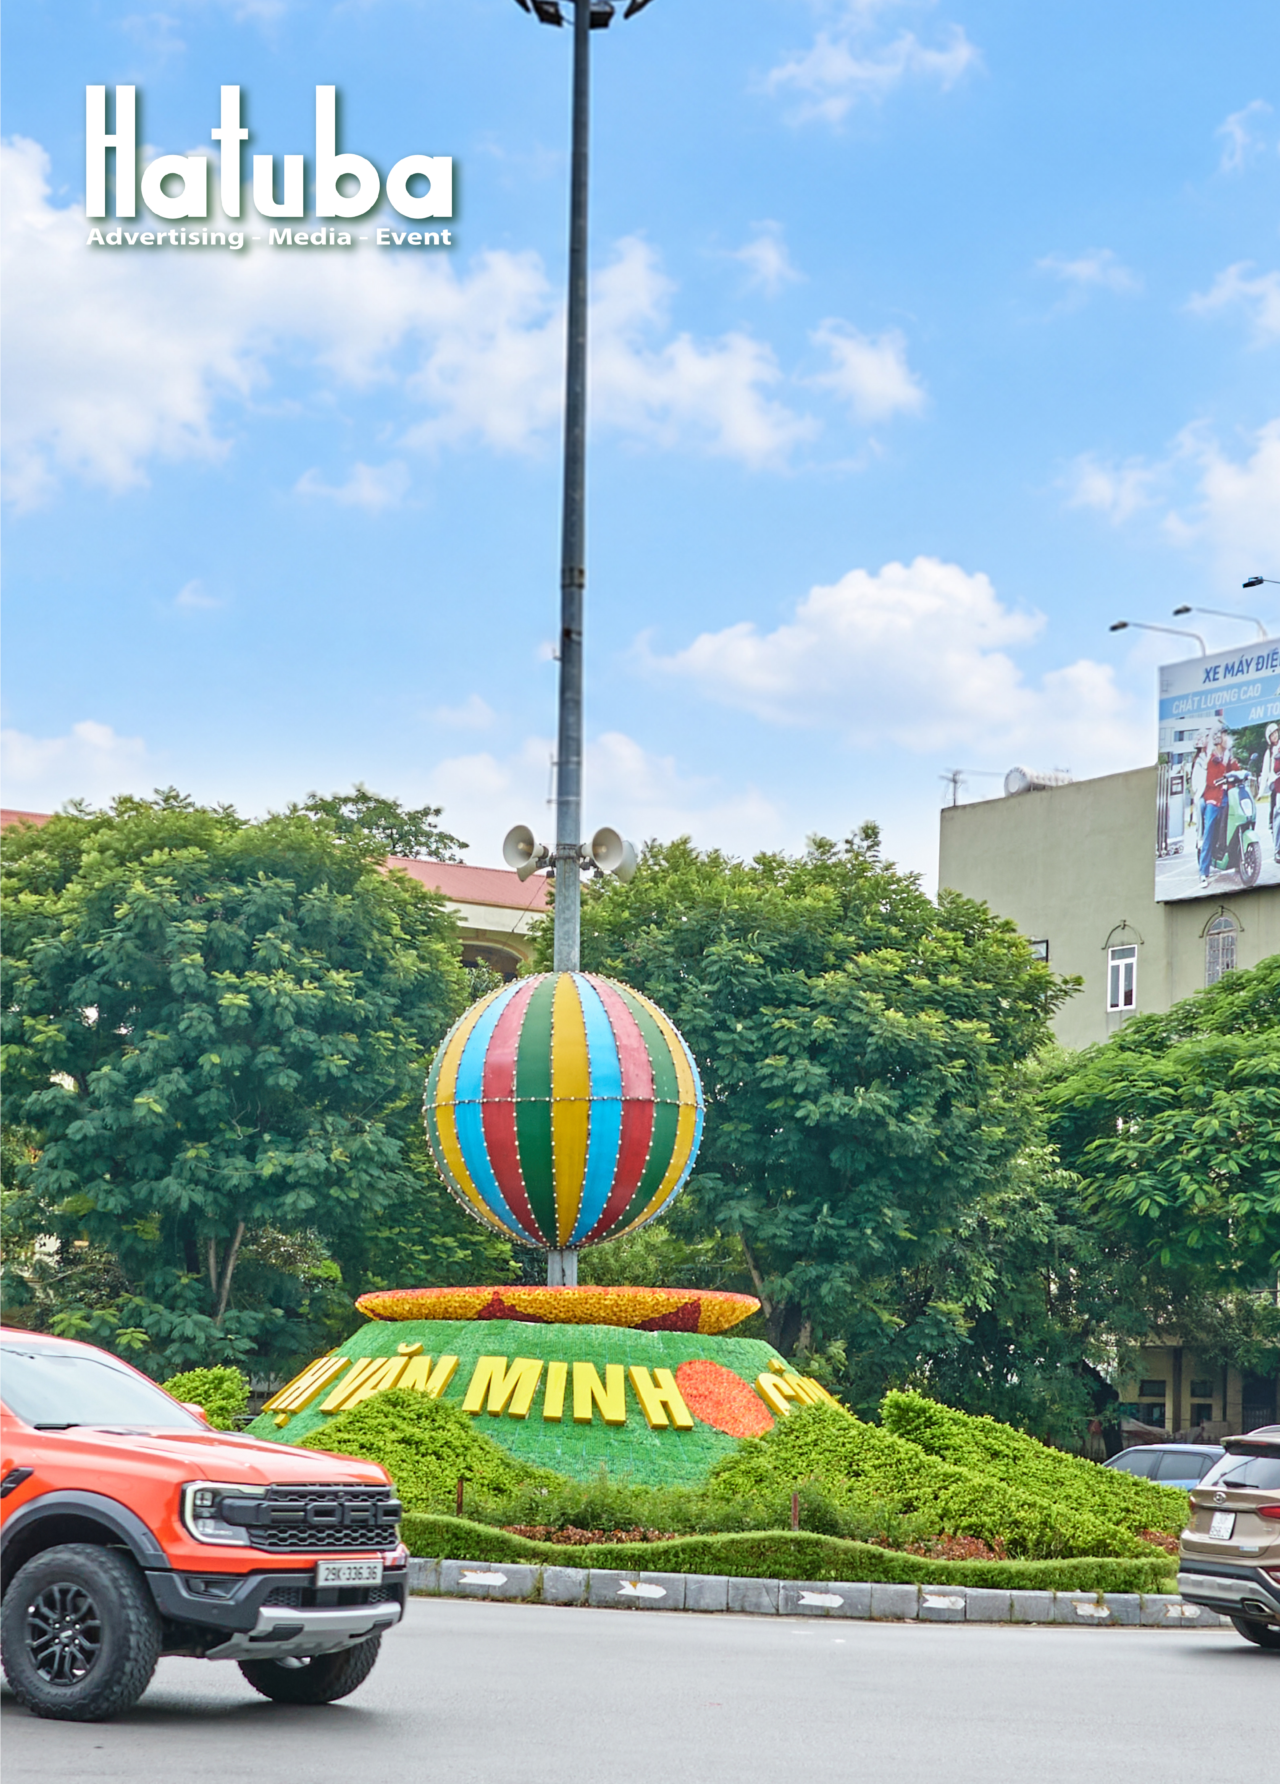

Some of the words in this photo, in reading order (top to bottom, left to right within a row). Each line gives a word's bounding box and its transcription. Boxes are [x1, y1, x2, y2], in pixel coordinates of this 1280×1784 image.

[1203, 665, 1221, 684] XE
[1223, 654, 1254, 679] MÁY
[1172, 692, 1200, 714] CHẤT
[1201, 687, 1238, 708] LƯỢNG
[1240, 683, 1262, 699] CAO
[1248, 707, 1265, 721] AN
[319, 1342, 459, 1414] VĂN
[462, 1355, 694, 1431] MINH
